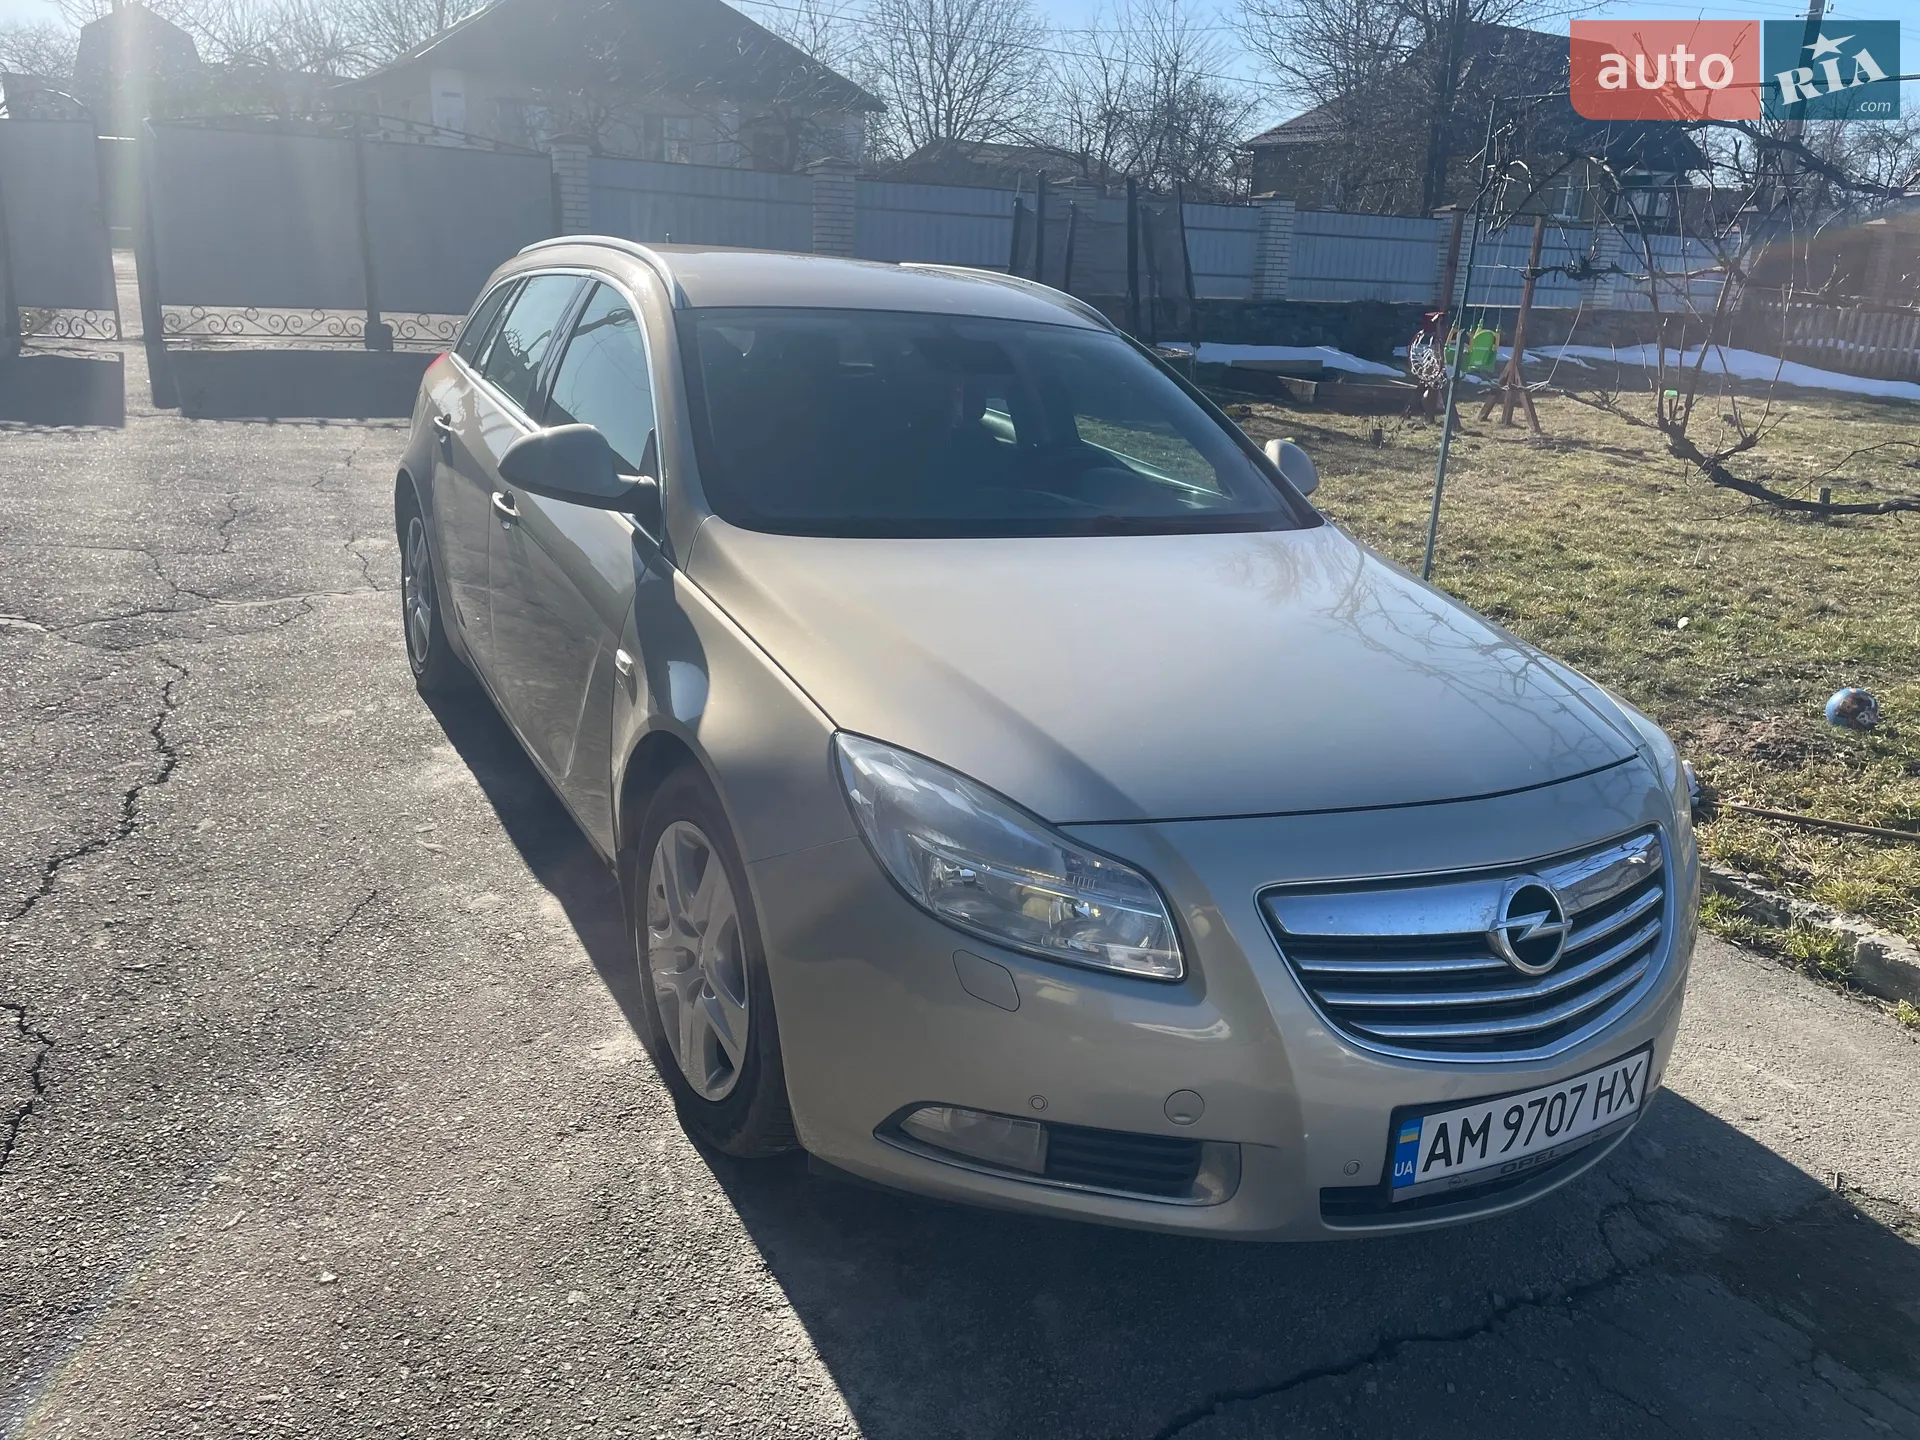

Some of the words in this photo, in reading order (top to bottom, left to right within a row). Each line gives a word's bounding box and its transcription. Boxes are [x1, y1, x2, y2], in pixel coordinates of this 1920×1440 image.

[1421, 1111, 1493, 1173] AM
[1500, 1083, 1588, 1152] 9707
[1593, 1060, 1643, 1121] HX
[1394, 1161, 1414, 1177] UA
[1499, 1151, 1563, 1174] OPEL
